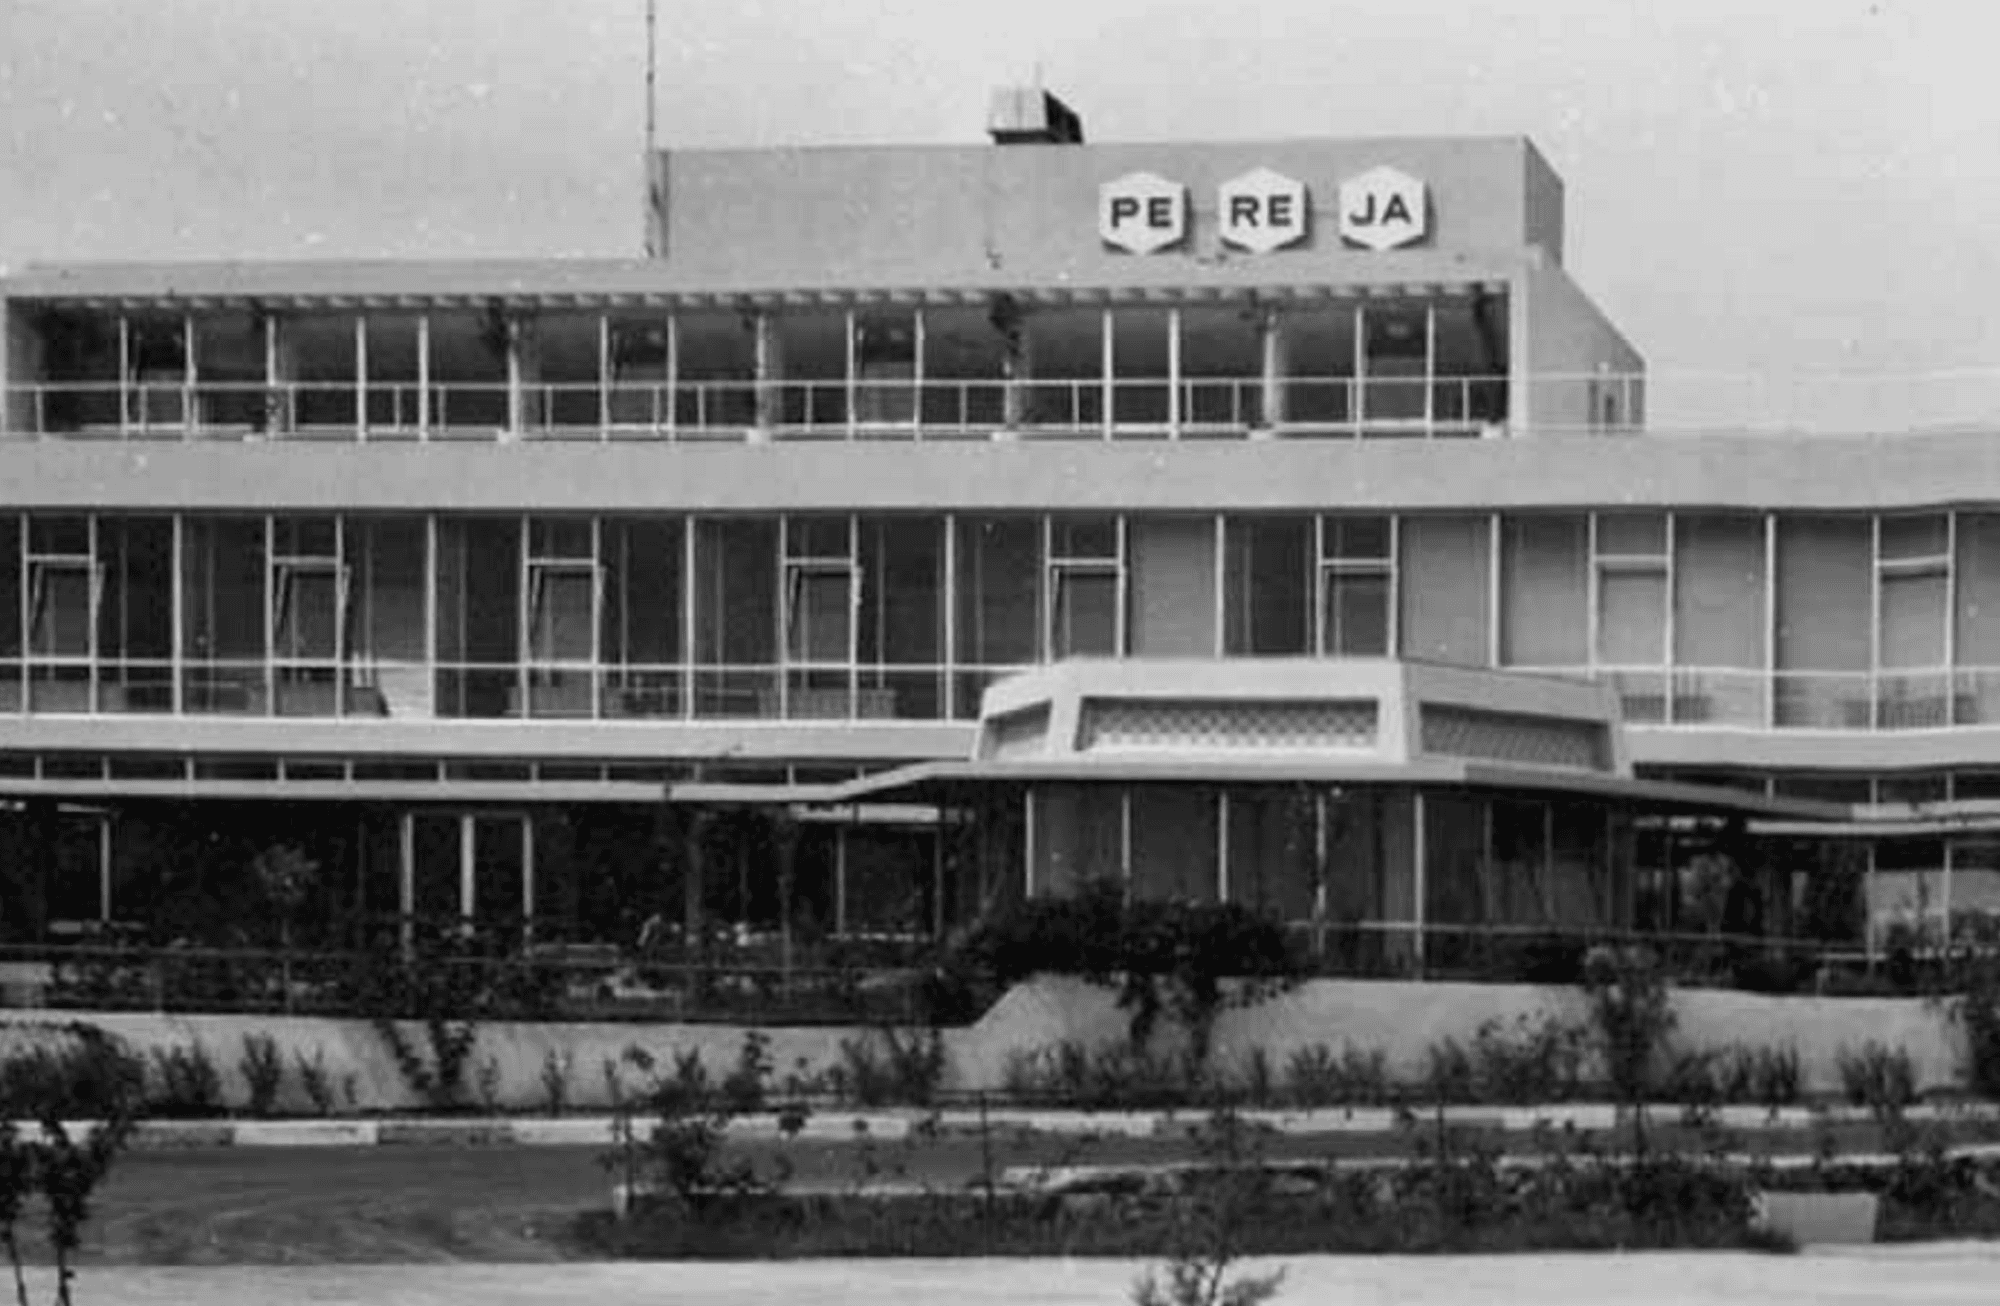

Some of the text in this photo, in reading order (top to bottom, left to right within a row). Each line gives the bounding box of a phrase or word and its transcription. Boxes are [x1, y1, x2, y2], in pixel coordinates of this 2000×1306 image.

[1110, 193, 1411, 228] PE RE JA
